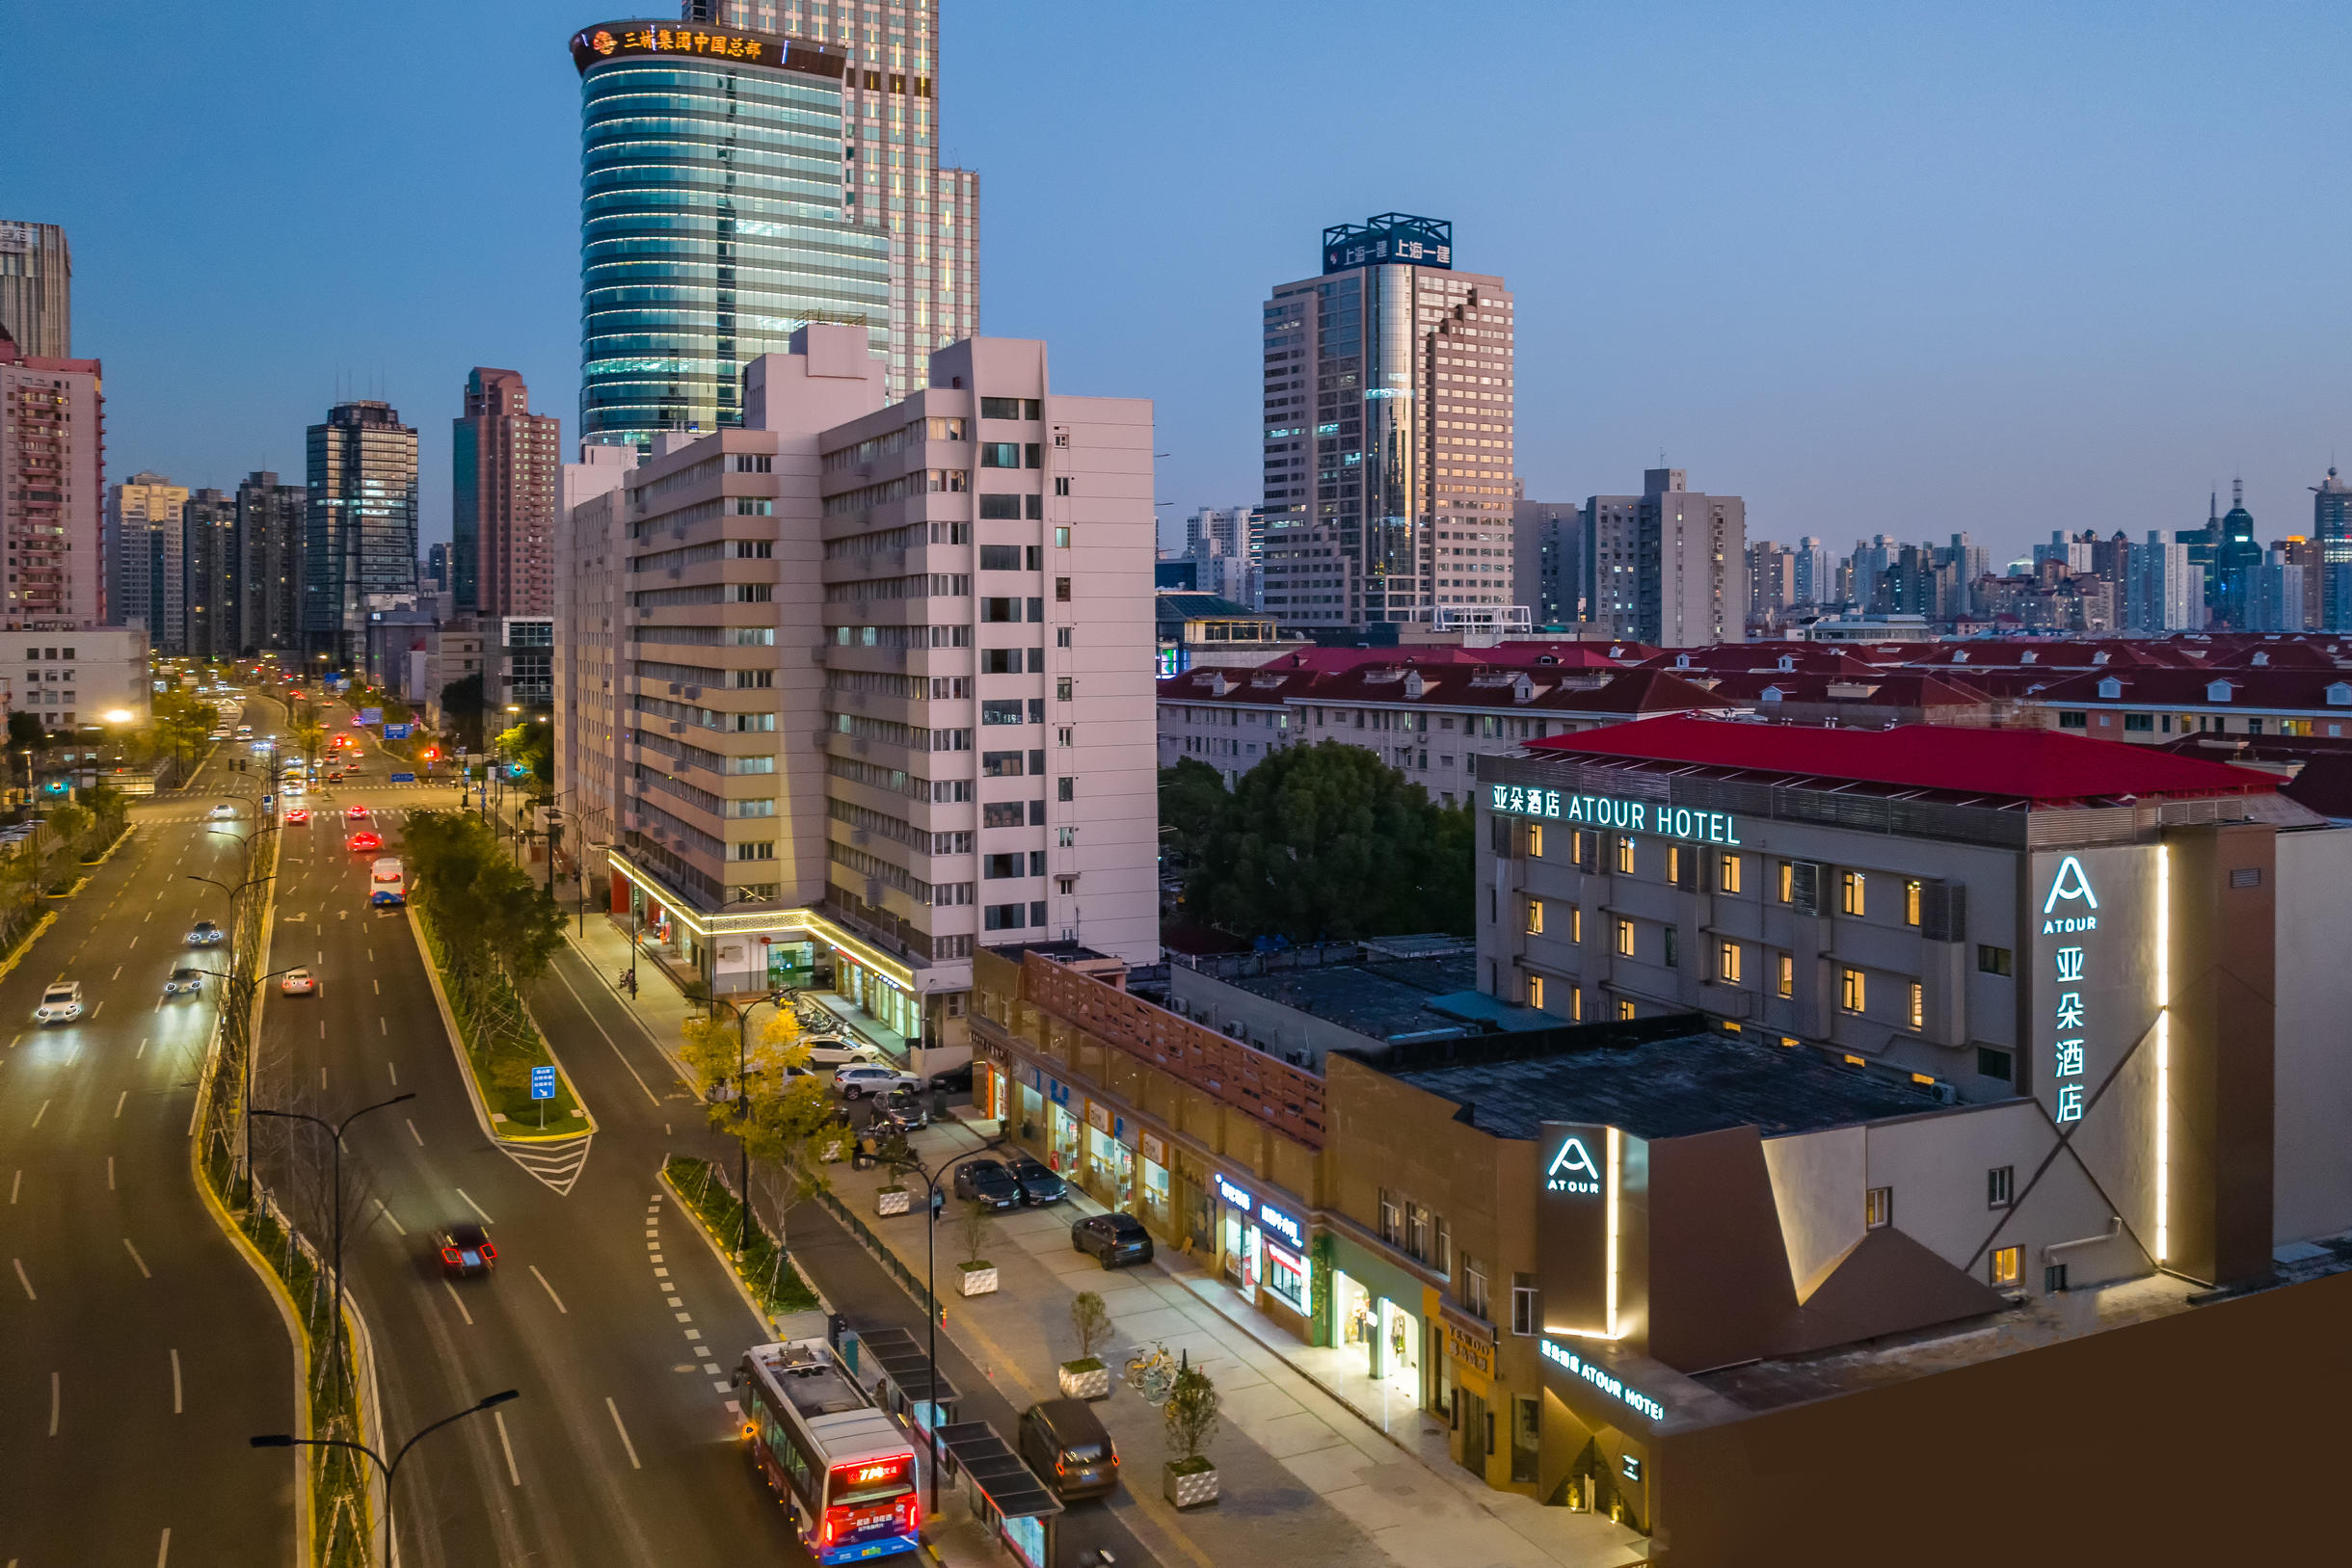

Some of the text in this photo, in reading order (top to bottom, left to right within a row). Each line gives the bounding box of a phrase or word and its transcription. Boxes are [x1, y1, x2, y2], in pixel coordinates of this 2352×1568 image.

[624, 28, 762, 61] 三林集团中国总部
[1344, 240, 1388, 266] 上海一建
[1395, 238, 1451, 264] 上海一建
[1493, 784, 1741, 844] 亚朵酒店 ATOUR HOTEL
[2043, 916, 2098, 935] ATOUR
[2055, 946, 2085, 1124] 亚朵酒店
[1547, 1179, 1599, 1194] ATOUR
[1581, 1364, 1621, 1399] ATOUR
